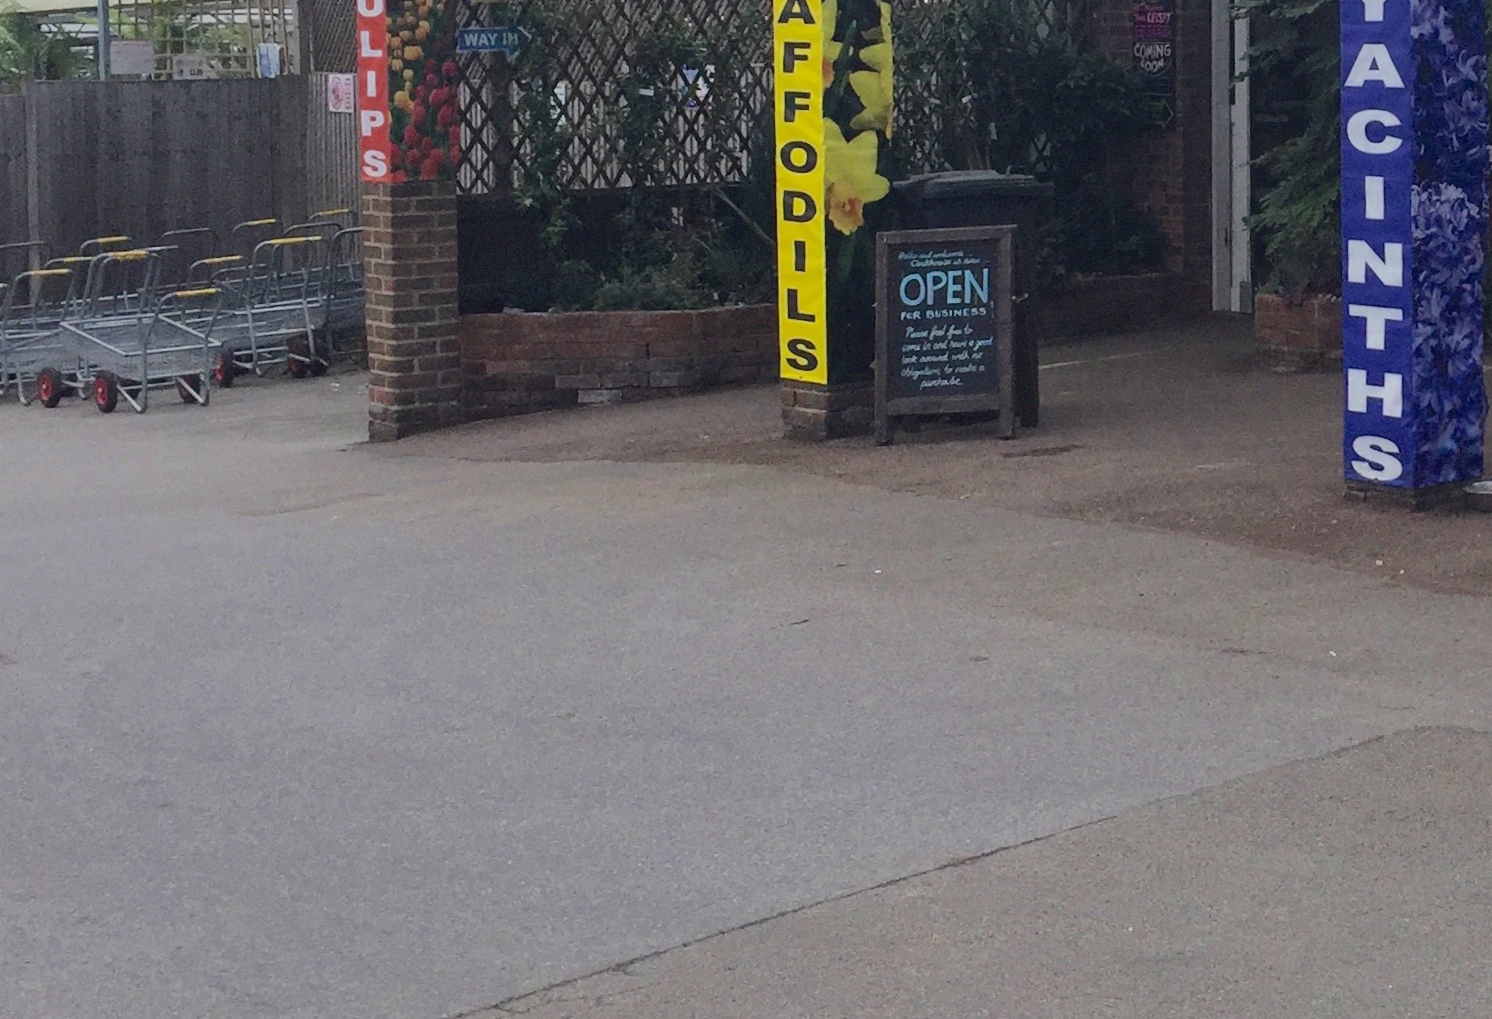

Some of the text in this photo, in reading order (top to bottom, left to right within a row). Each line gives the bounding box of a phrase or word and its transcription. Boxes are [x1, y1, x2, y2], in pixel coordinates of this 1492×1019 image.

[464, 32, 519, 47] WAY IN
[1133, 42, 1172, 59] COMING
[899, 268, 989, 306] OPEN
[900, 310, 922, 320] FOR
[932, 339, 949, 350] and
